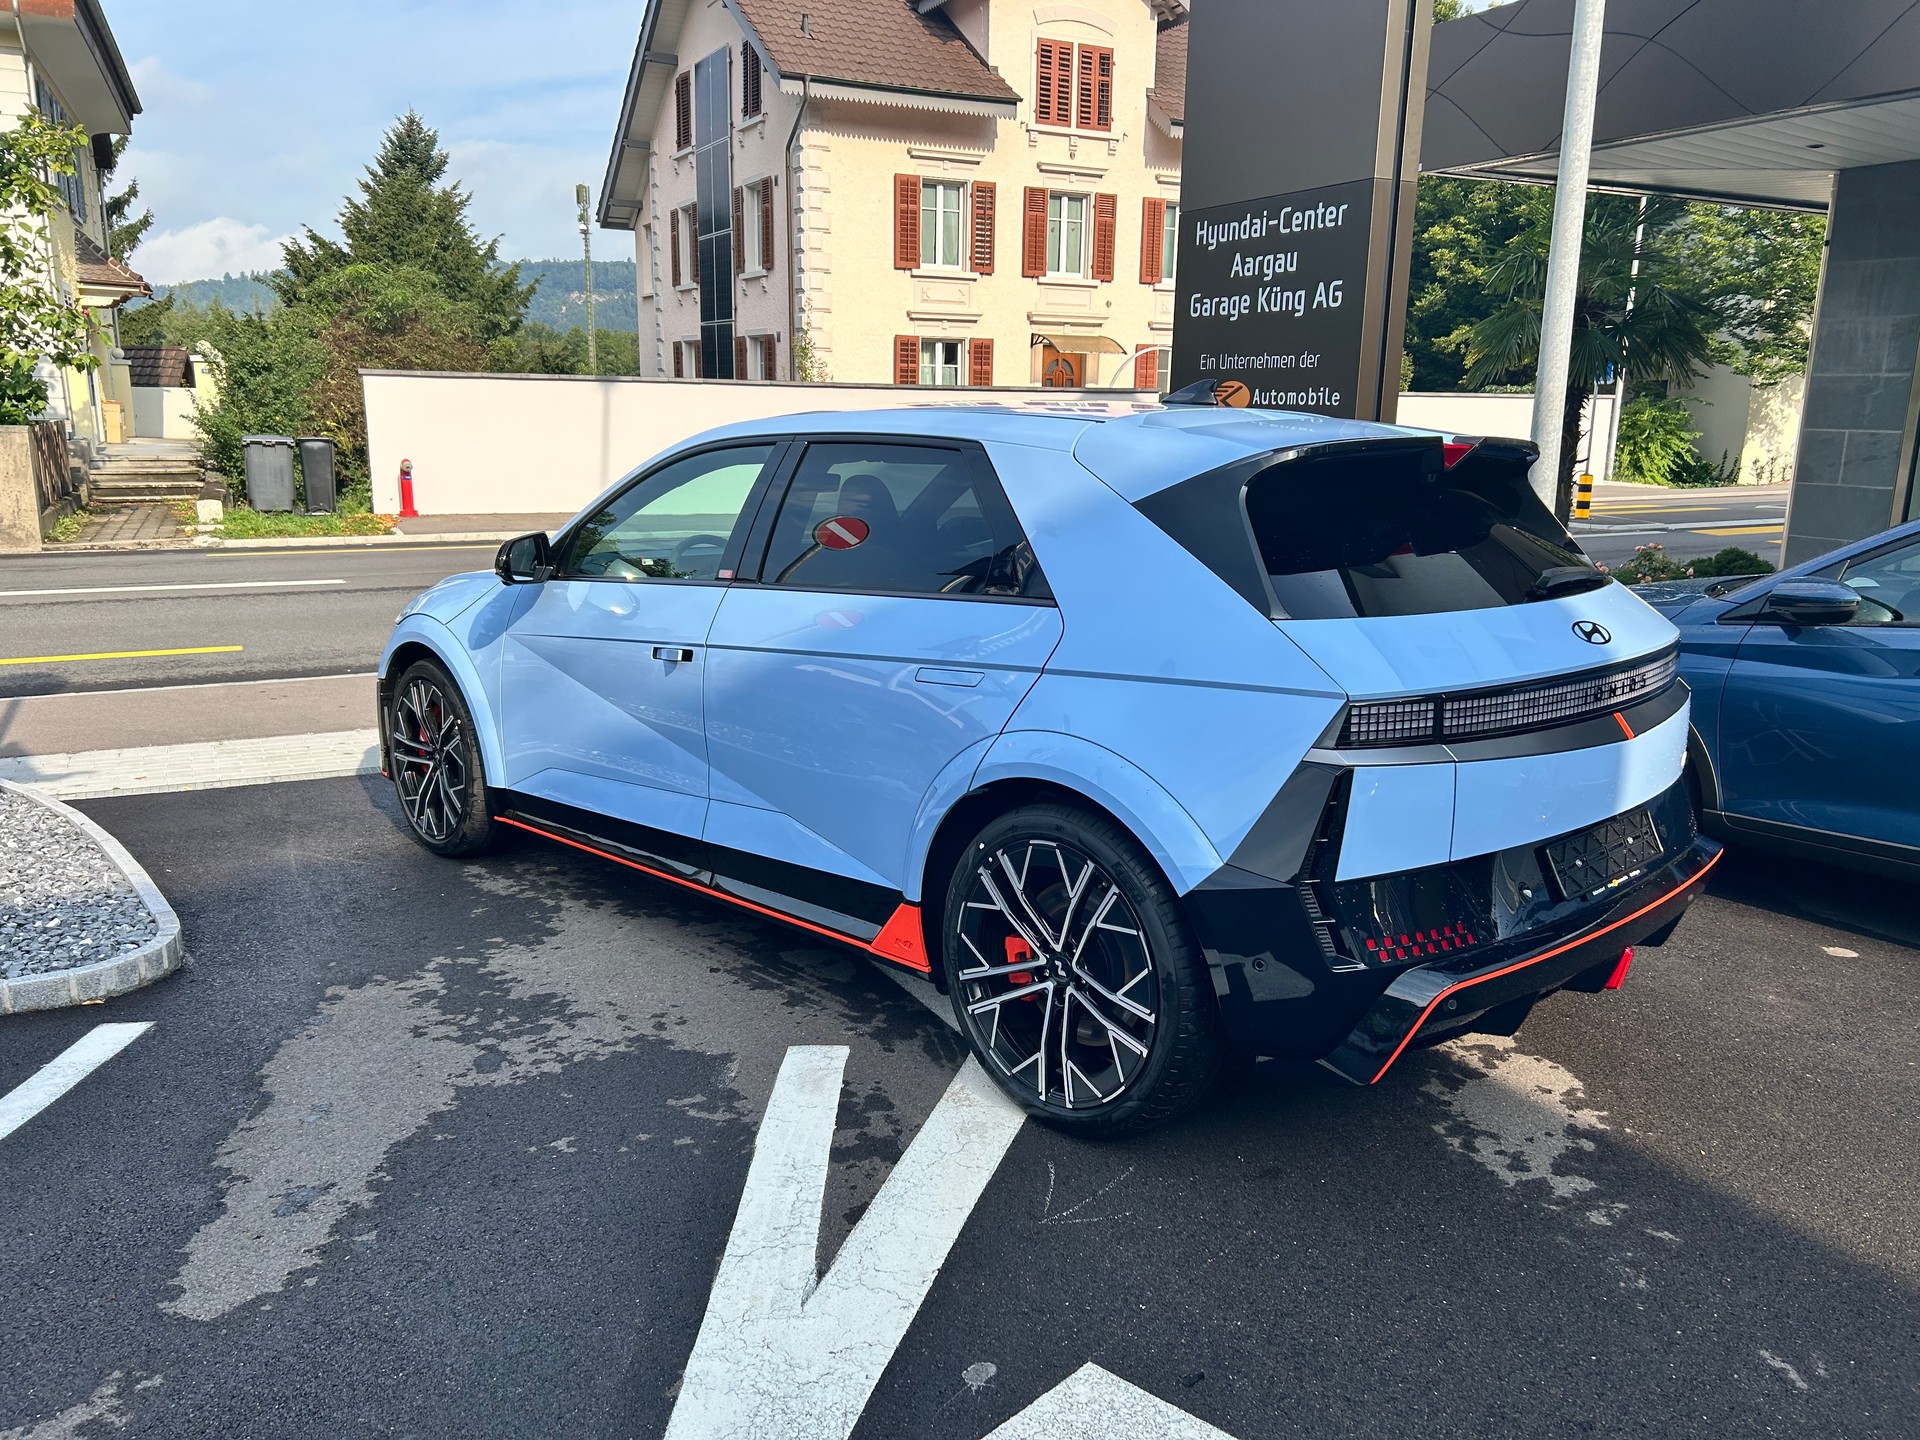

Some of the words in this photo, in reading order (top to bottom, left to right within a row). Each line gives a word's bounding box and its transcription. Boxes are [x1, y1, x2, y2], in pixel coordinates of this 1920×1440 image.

[1195, 201, 1349, 251] Hyundai-Center
[1230, 251, 1298, 282] Aargau
[1189, 293, 1251, 322] Garage
[1257, 286, 1306, 317] Küng
[1312, 279, 1344, 310] AG
[1200, 354, 1216, 370] Ein
[1219, 352, 1296, 370] Unternehmen
[1299, 350, 1321, 368] der
[1252, 387, 1341, 406] Automobile
